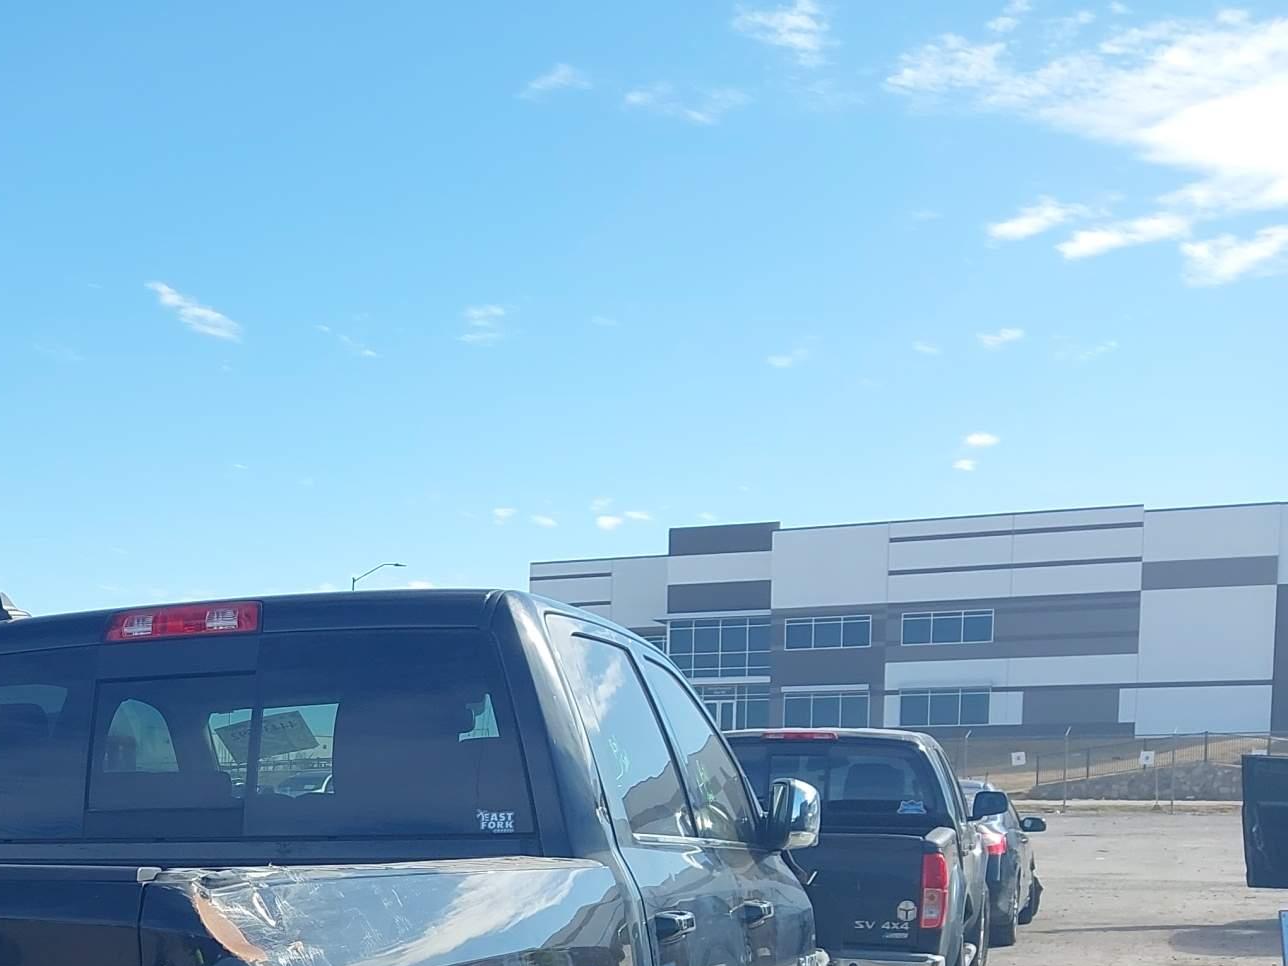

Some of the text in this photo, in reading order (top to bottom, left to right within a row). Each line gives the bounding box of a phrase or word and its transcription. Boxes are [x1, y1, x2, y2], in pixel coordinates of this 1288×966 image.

[482, 812, 514, 821] EAST
[481, 821, 514, 830] FORK
[854, 921, 875, 929] SV
